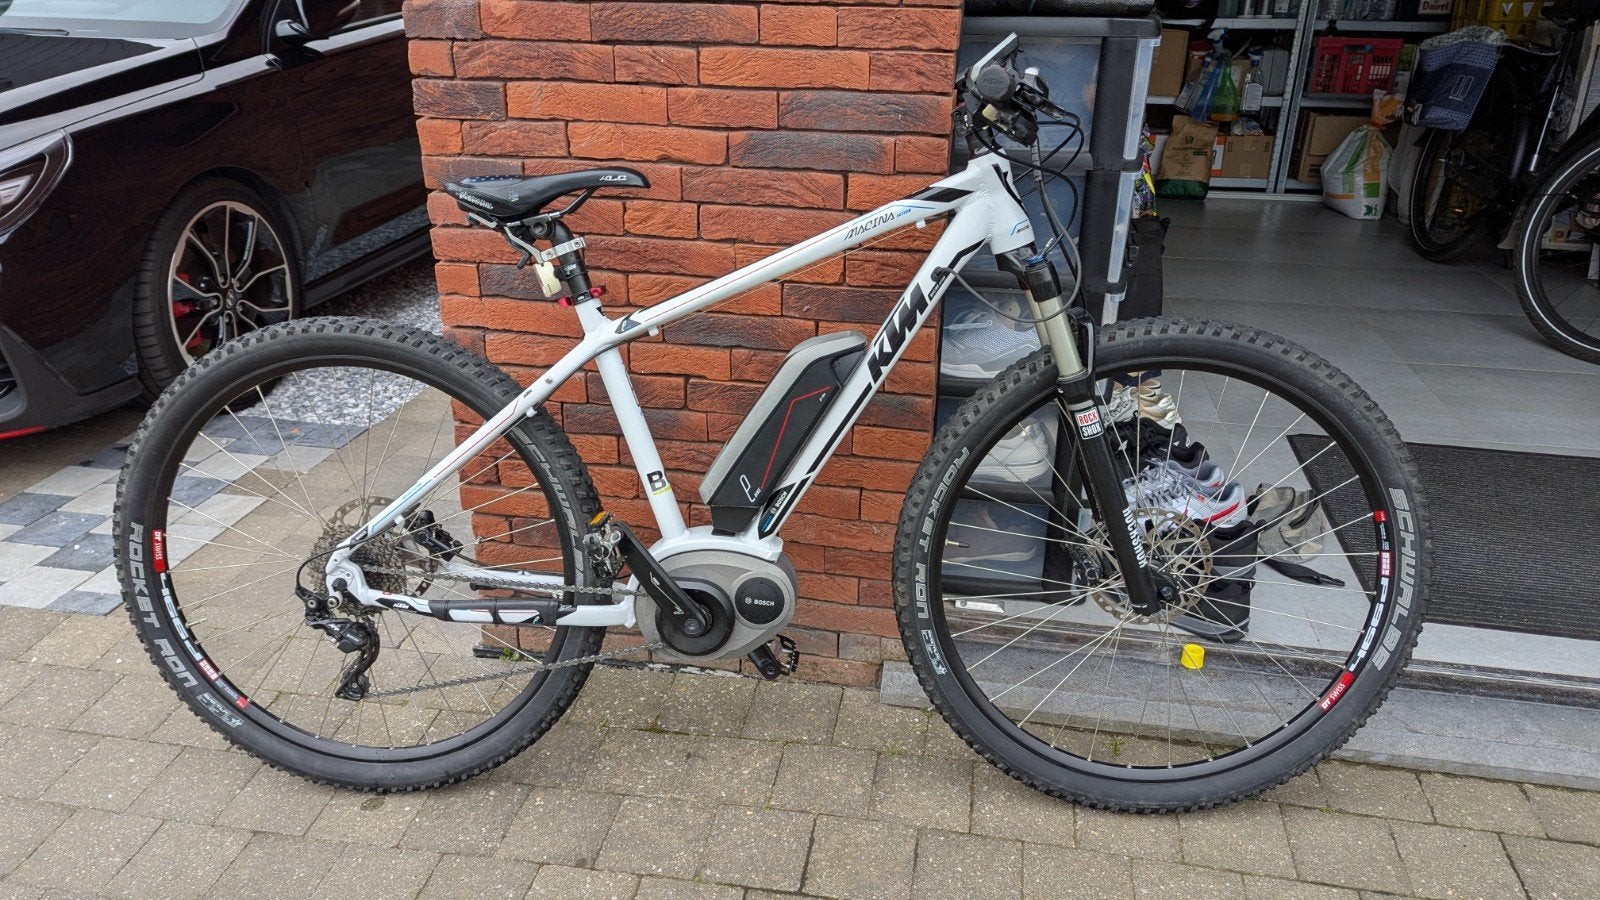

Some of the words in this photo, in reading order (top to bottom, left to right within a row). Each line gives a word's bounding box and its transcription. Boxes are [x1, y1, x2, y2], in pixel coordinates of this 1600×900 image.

[1423, 1, 1449, 10] Duvel
[844, 211, 896, 241] MACINA
[867, 282, 931, 384] KTM
[1078, 411, 1098, 425] ROCK
[1082, 422, 1102, 437] SHOX
[774, 491, 788, 507] BOSCH
[917, 446, 970, 553] ROCKET
[153, 531, 163, 542] DT
[155, 542, 163, 561] SWISS
[915, 562, 930, 619] RON
[1371, 487, 1416, 671] SCHWALBE
[129, 521, 160, 629] ROCKET
[153, 638, 198, 688] RON
[1321, 697, 1331, 710] DT
[1329, 682, 1346, 701] SWISS
